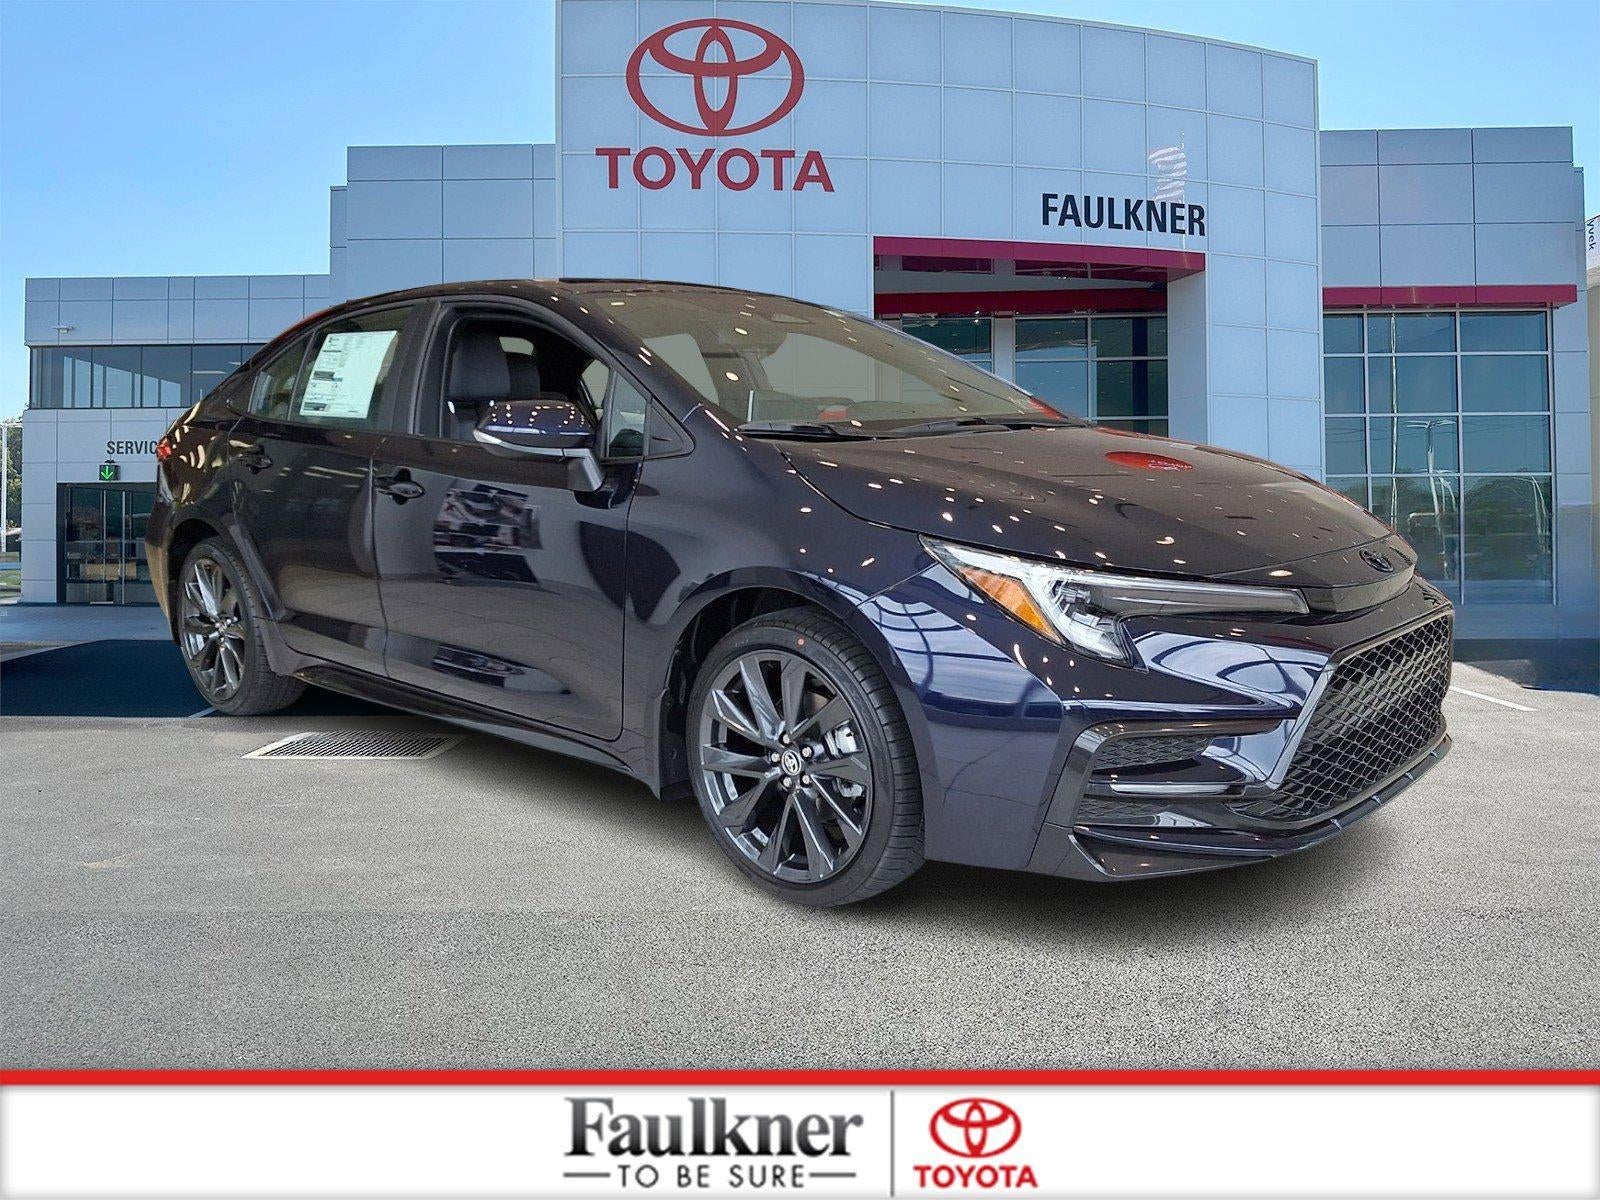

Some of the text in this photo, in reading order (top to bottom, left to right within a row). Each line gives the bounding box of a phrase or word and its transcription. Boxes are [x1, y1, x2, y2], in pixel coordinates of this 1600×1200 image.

[596, 147, 835, 192] TOYOTA
[1041, 192, 1206, 237] FAULKNER
[106, 440, 158, 455] SERVIC
